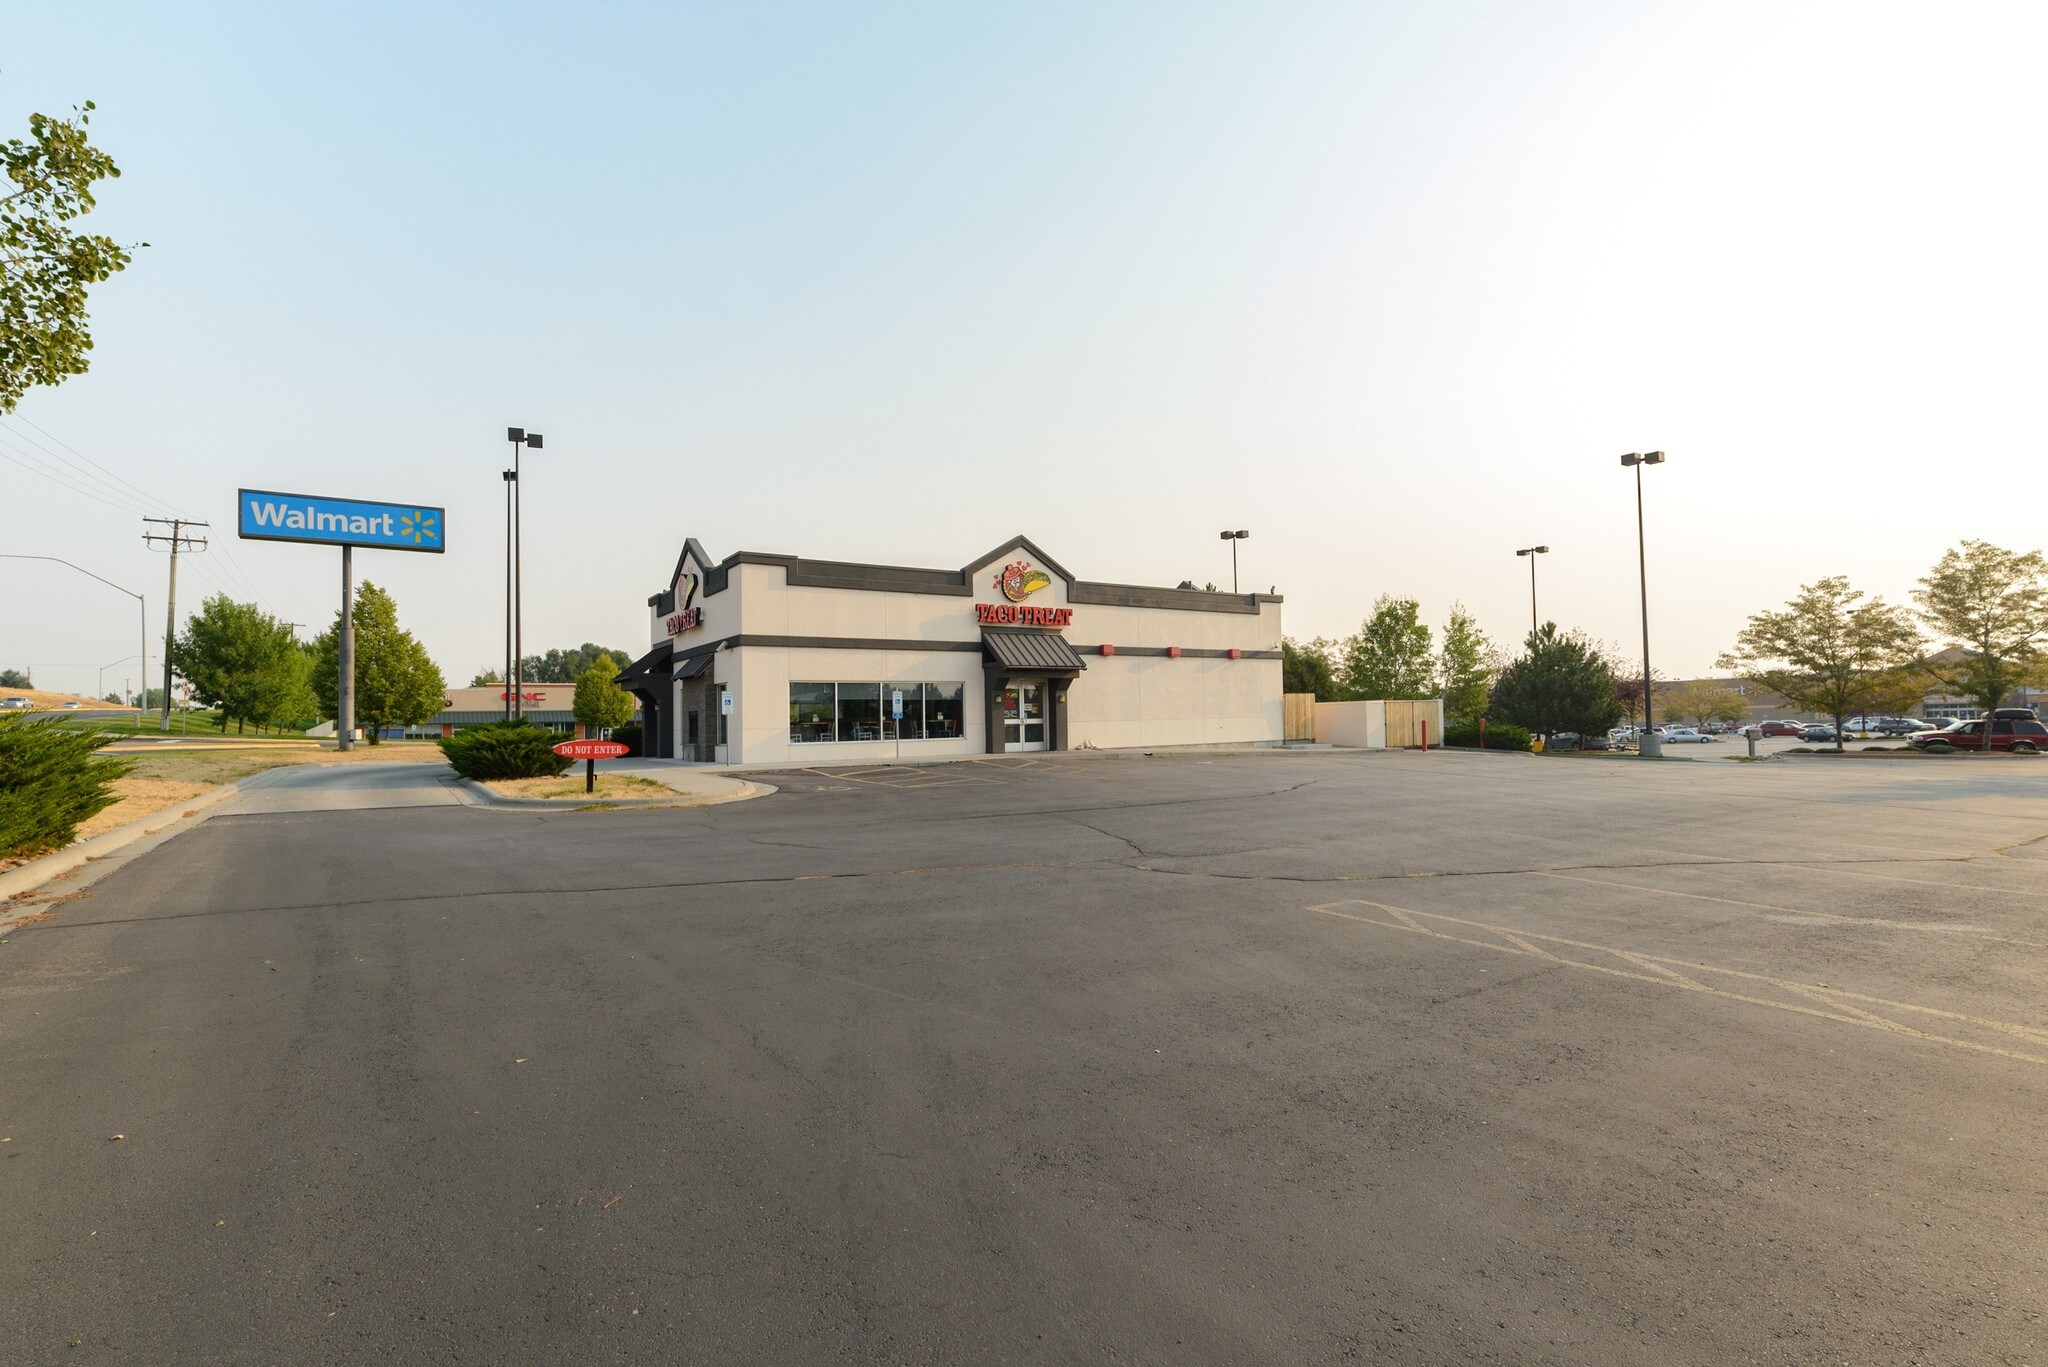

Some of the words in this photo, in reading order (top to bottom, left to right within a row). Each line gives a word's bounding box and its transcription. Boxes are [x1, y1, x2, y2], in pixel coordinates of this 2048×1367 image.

[251, 501, 394, 536] Walmart
[976, 603, 1018, 623] TACO
[1020, 606, 1073, 626] TREAT
[561, 745, 573, 755] DO
[575, 745, 592, 755] NOT
[594, 745, 623, 755] ENTER
